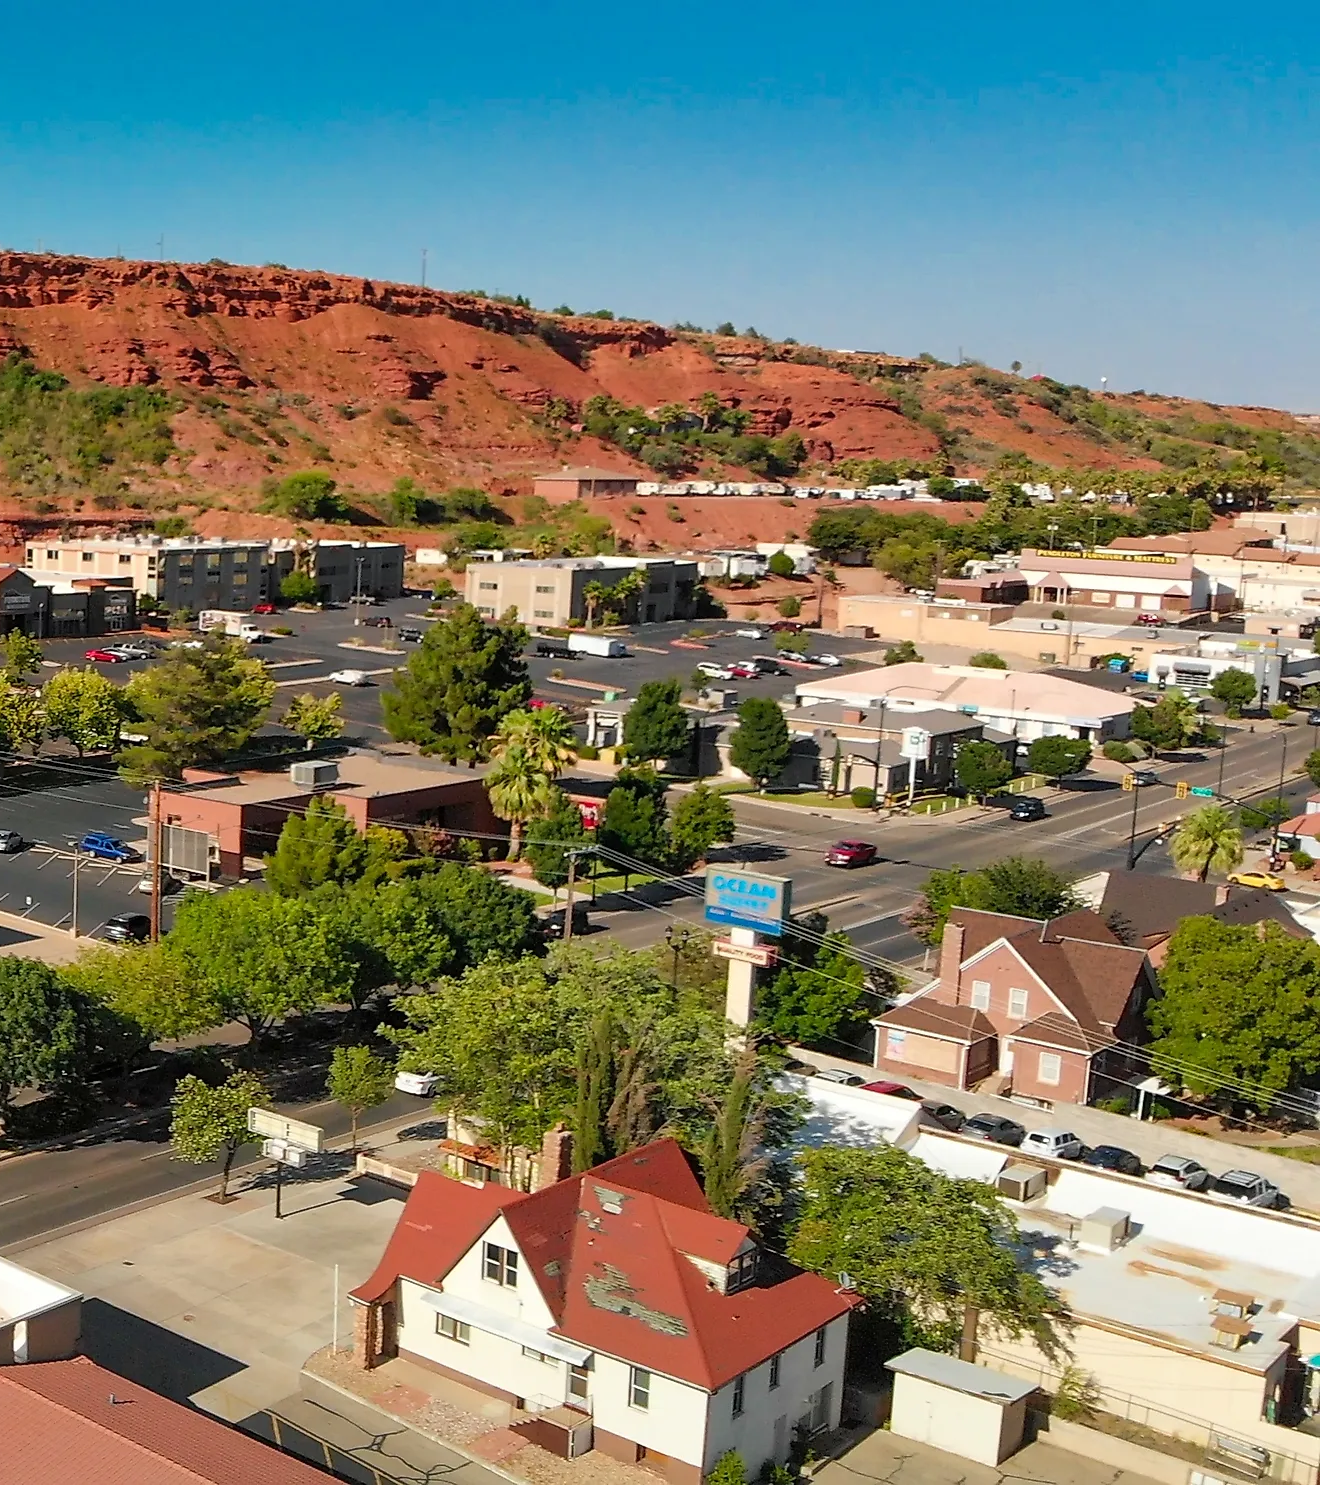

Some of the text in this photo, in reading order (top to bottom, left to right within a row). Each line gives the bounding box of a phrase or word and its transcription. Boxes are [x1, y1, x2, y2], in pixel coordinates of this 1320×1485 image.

[1037, 550, 1081, 558] PENDLETON
[1083, 552, 1123, 560] FURNITURE
[1134, 555, 1175, 563] MATTRESS
[712, 875, 777, 900] OCEAN
